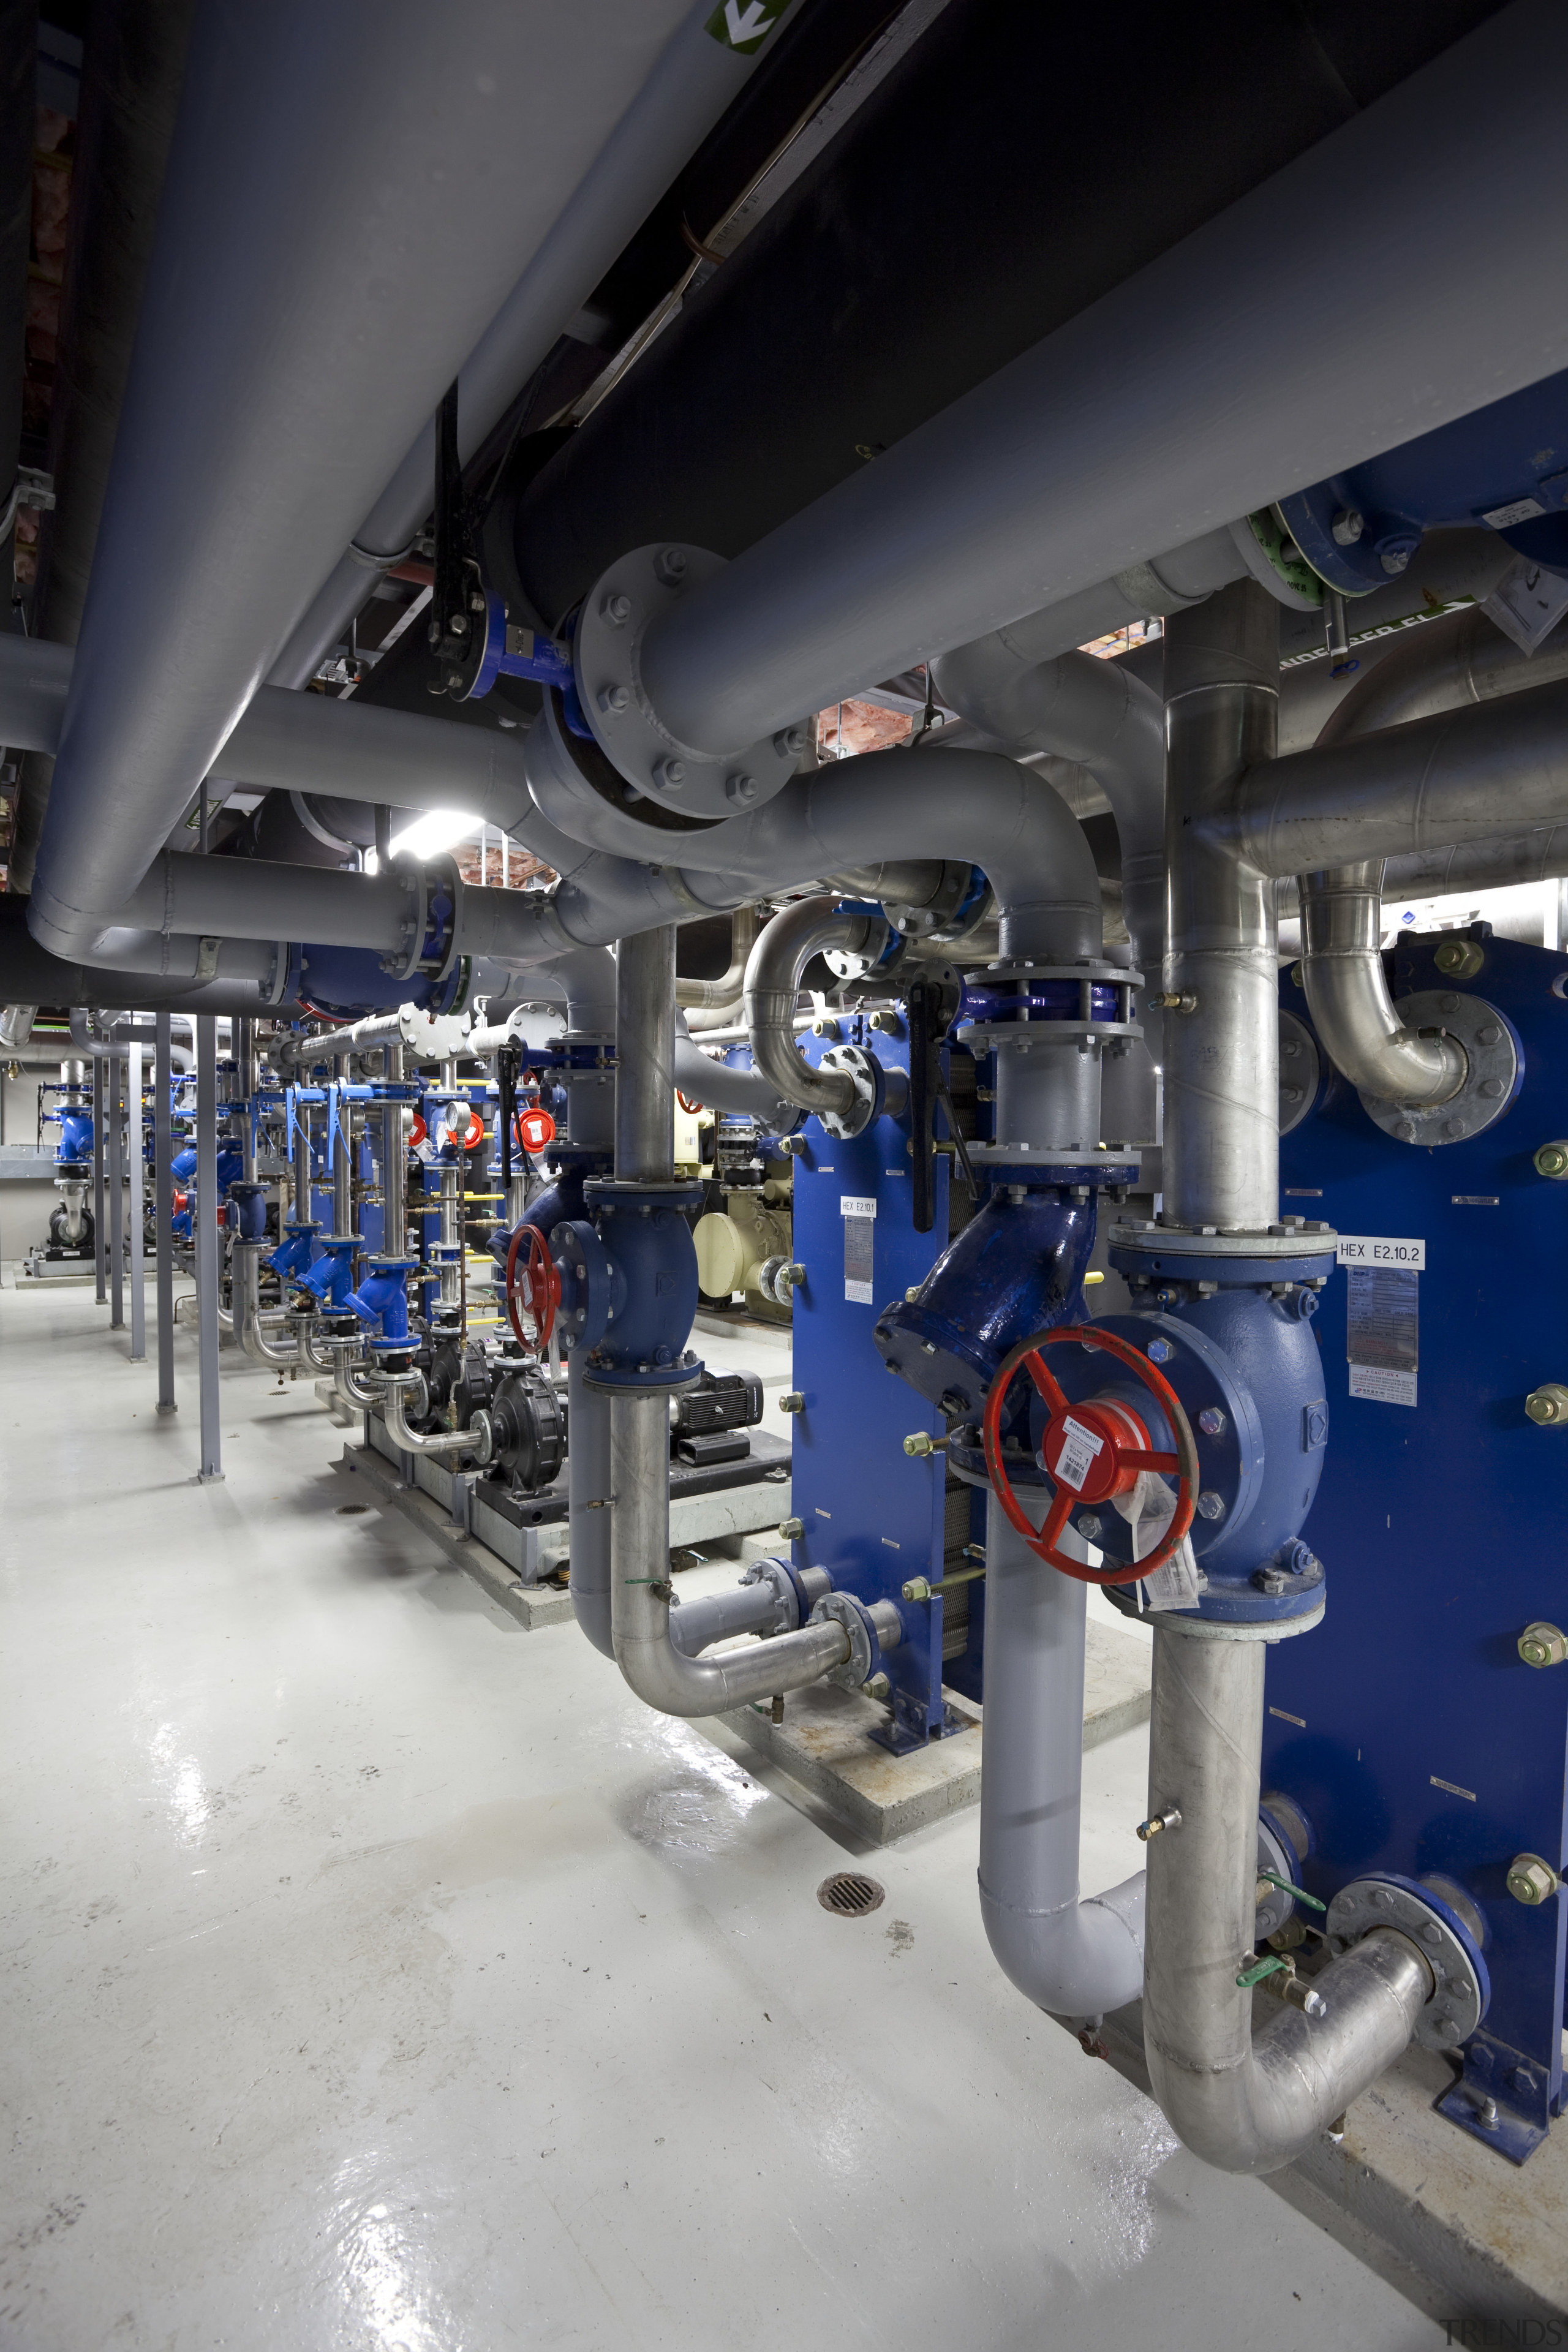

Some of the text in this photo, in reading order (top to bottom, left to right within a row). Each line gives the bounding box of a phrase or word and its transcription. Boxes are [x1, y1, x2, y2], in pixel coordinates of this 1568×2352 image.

[843, 1201, 874, 1213] HEX E2.10.1
[1341, 1243, 1419, 1262] HEX E2.10.2
[1069, 1421, 1099, 1445] Attention!!!
[1066, 1455, 1085, 1471] 1421874
